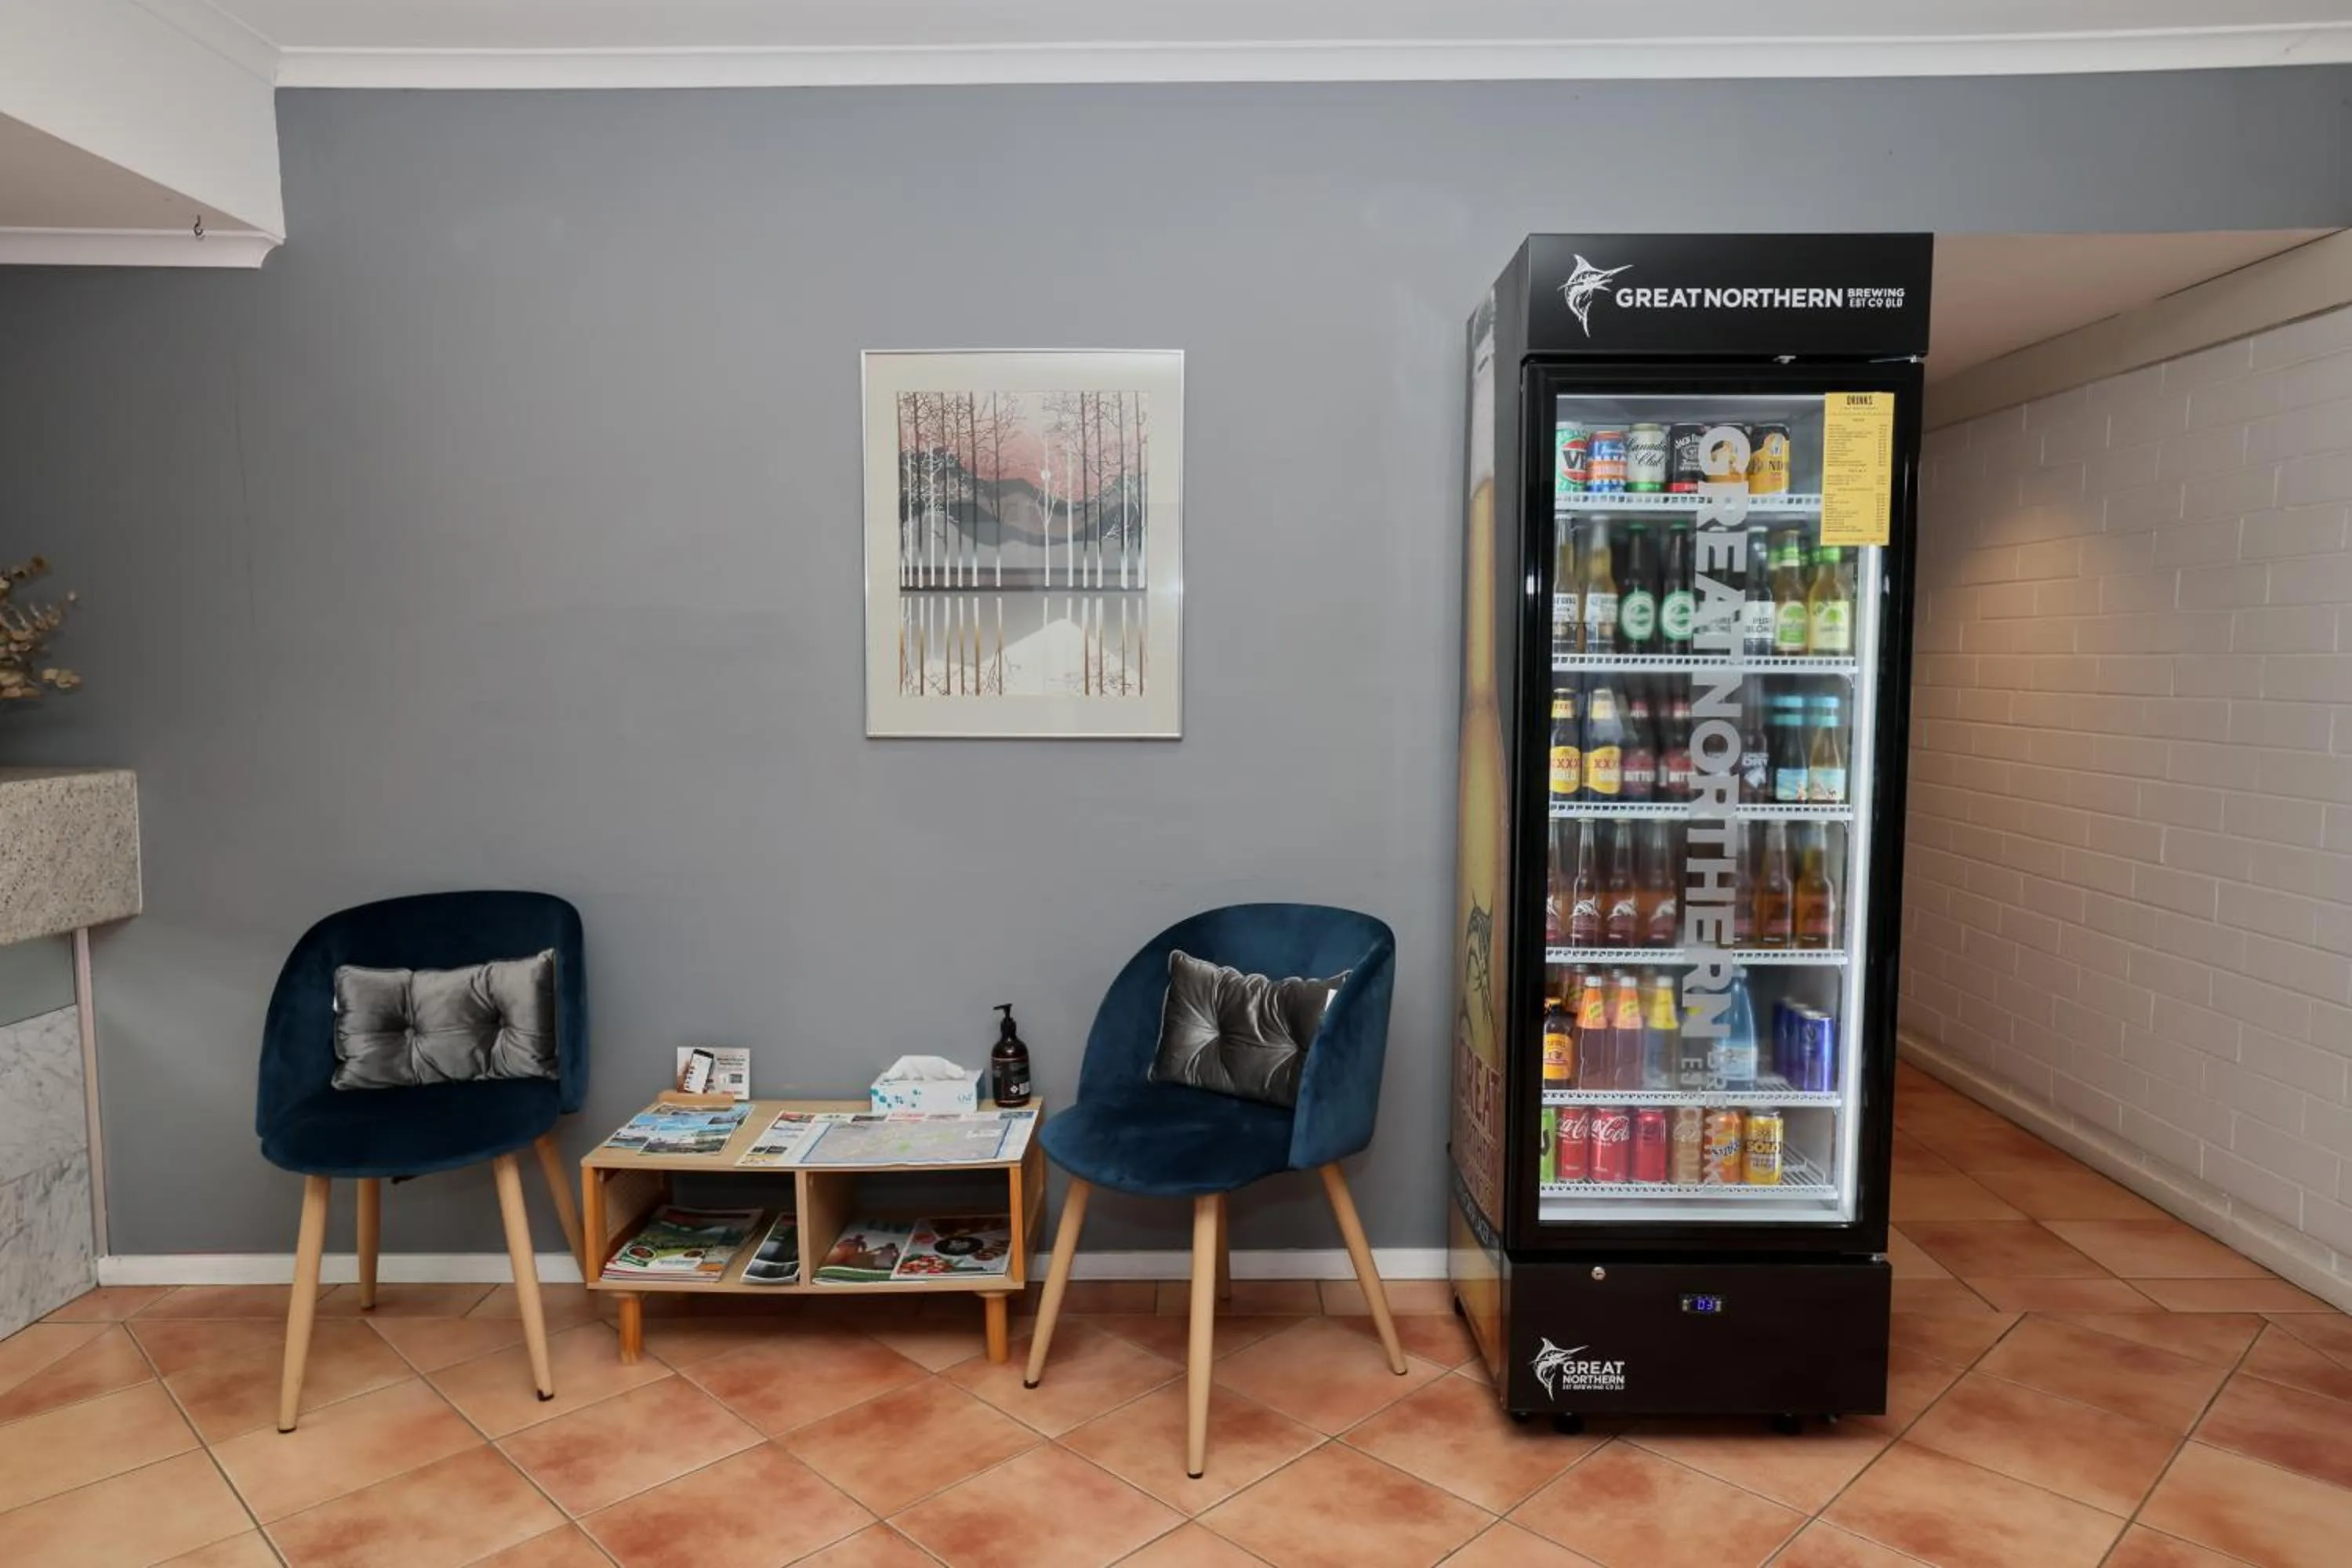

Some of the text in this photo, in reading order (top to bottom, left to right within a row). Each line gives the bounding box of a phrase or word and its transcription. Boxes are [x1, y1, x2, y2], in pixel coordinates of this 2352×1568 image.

[1616, 288, 1843, 308] GREAT NORTHERN
[1847, 288, 1905, 297] BREWING
[1846, 394, 1873, 405] DRINKS
[1693, 426, 1751, 665] GREAT
[1681, 672, 1743, 1037] NORTHERN
[1563, 1360, 1625, 1374] GREAT
[1563, 1374, 1625, 1384] NORTHERN
